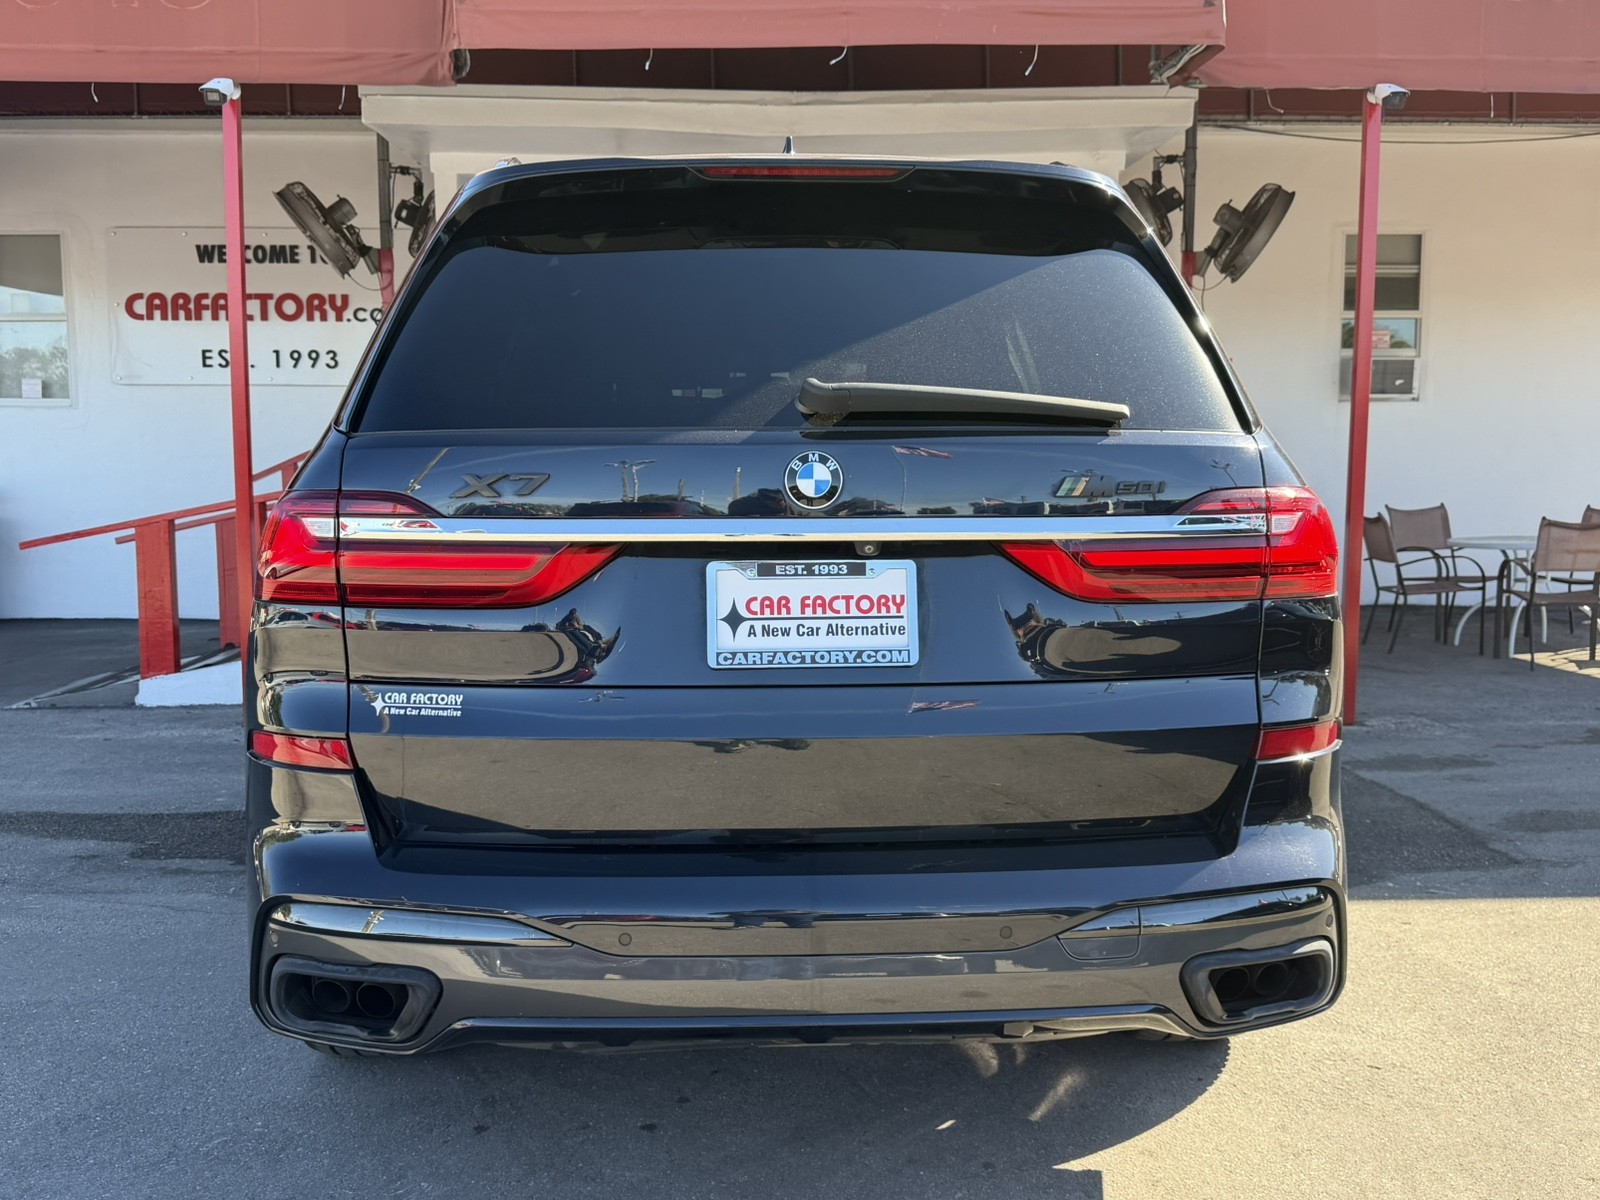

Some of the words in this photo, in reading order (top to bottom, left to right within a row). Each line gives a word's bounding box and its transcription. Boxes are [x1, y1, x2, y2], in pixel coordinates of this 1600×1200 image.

[195, 244, 300, 264] WECOME
[307, 244, 329, 265] T
[201, 349, 255, 368] ES.
[272, 349, 339, 369] 1993
[791, 453, 838, 471] BMW
[449, 473, 551, 498] X7
[775, 564, 807, 575] EST.
[811, 564, 848, 575] 1993
[744, 596, 792, 616] CAR
[800, 594, 905, 616] FACTORY
[747, 625, 757, 638] A
[761, 625, 791, 638] New
[796, 624, 821, 637] Car
[825, 622, 906, 637] Alternative
[718, 651, 910, 665] CARFACTORY.COM
[385, 692, 407, 704] CAR
[410, 693, 464, 706] FACTORY
[383, 707, 389, 715] A
[390, 707, 406, 715] New
[406, 708, 420, 716] Car
[420, 708, 462, 717] Alternative
